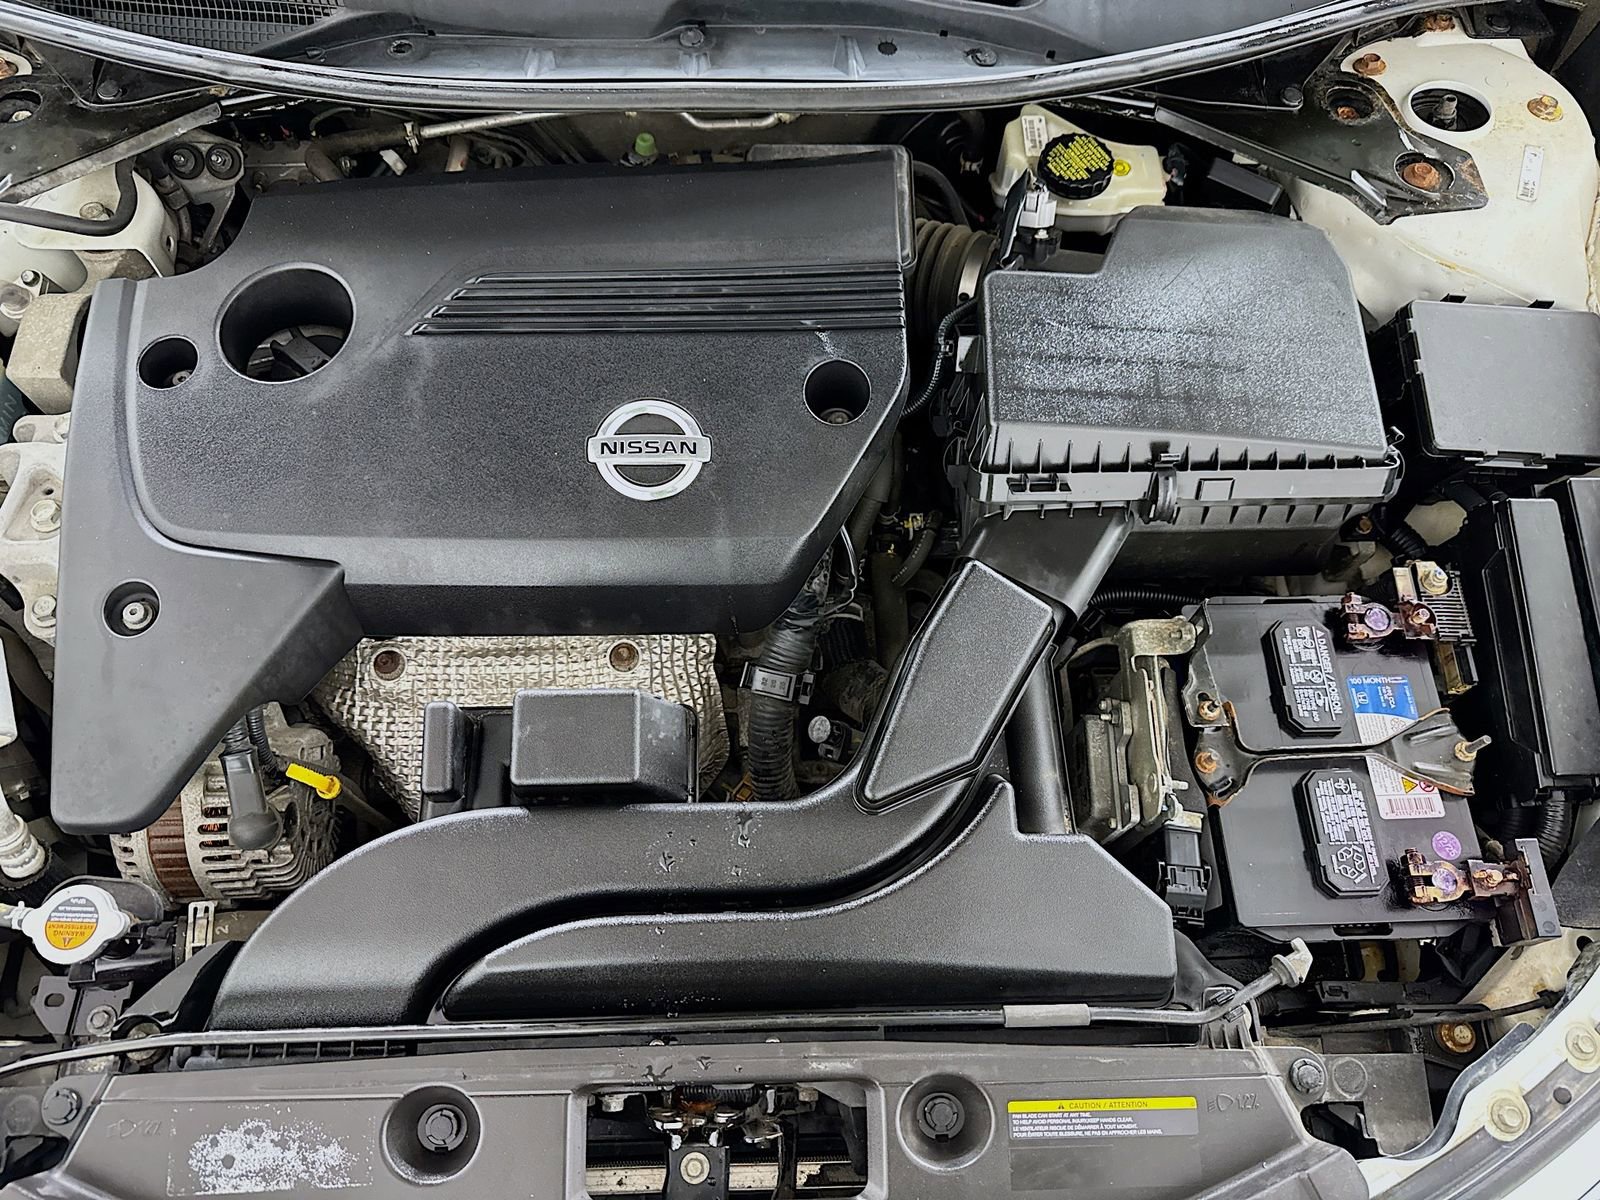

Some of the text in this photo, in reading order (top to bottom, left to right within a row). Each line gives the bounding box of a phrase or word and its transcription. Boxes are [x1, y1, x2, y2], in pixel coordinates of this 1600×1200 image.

[601, 441, 697, 455] NISSAN
[1318, 638, 1333, 674] DANGER
[1328, 681, 1343, 714] POISON
[1108, 1101, 1148, 1109] ATTENTION
